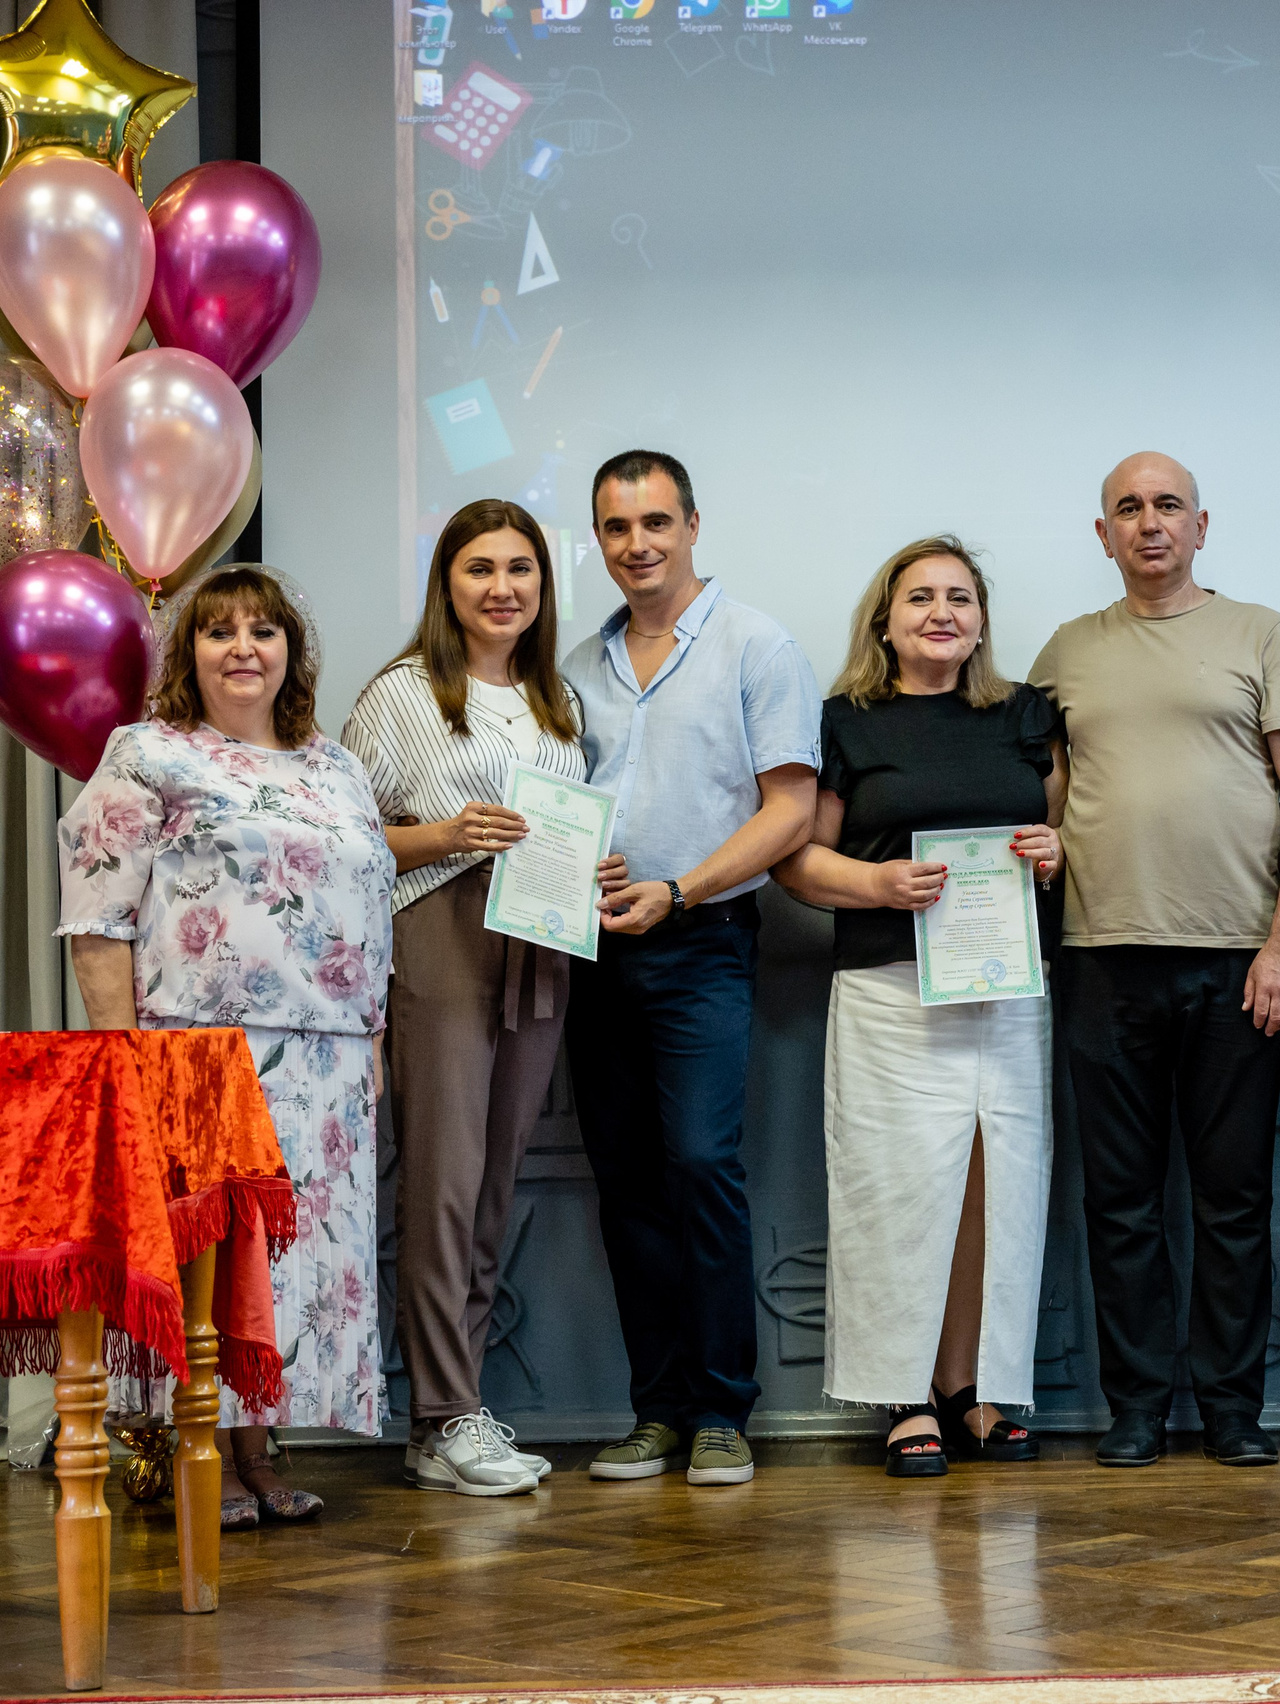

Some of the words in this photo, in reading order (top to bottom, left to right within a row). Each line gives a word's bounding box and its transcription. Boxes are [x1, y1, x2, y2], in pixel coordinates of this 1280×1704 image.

[486, 25, 507, 34] User
[548, 25, 582, 34] Yandex
[614, 23, 650, 36] Google
[679, 23, 722, 34] Telegram
[743, 23, 793, 33] WhatsApp
[829, 22, 842, 31] VK
[613, 37, 653, 46] Chrome
[804, 35, 868, 46] Мессенджер
[948, 869, 1013, 879] ГОДАРСТВЕННОЕ
